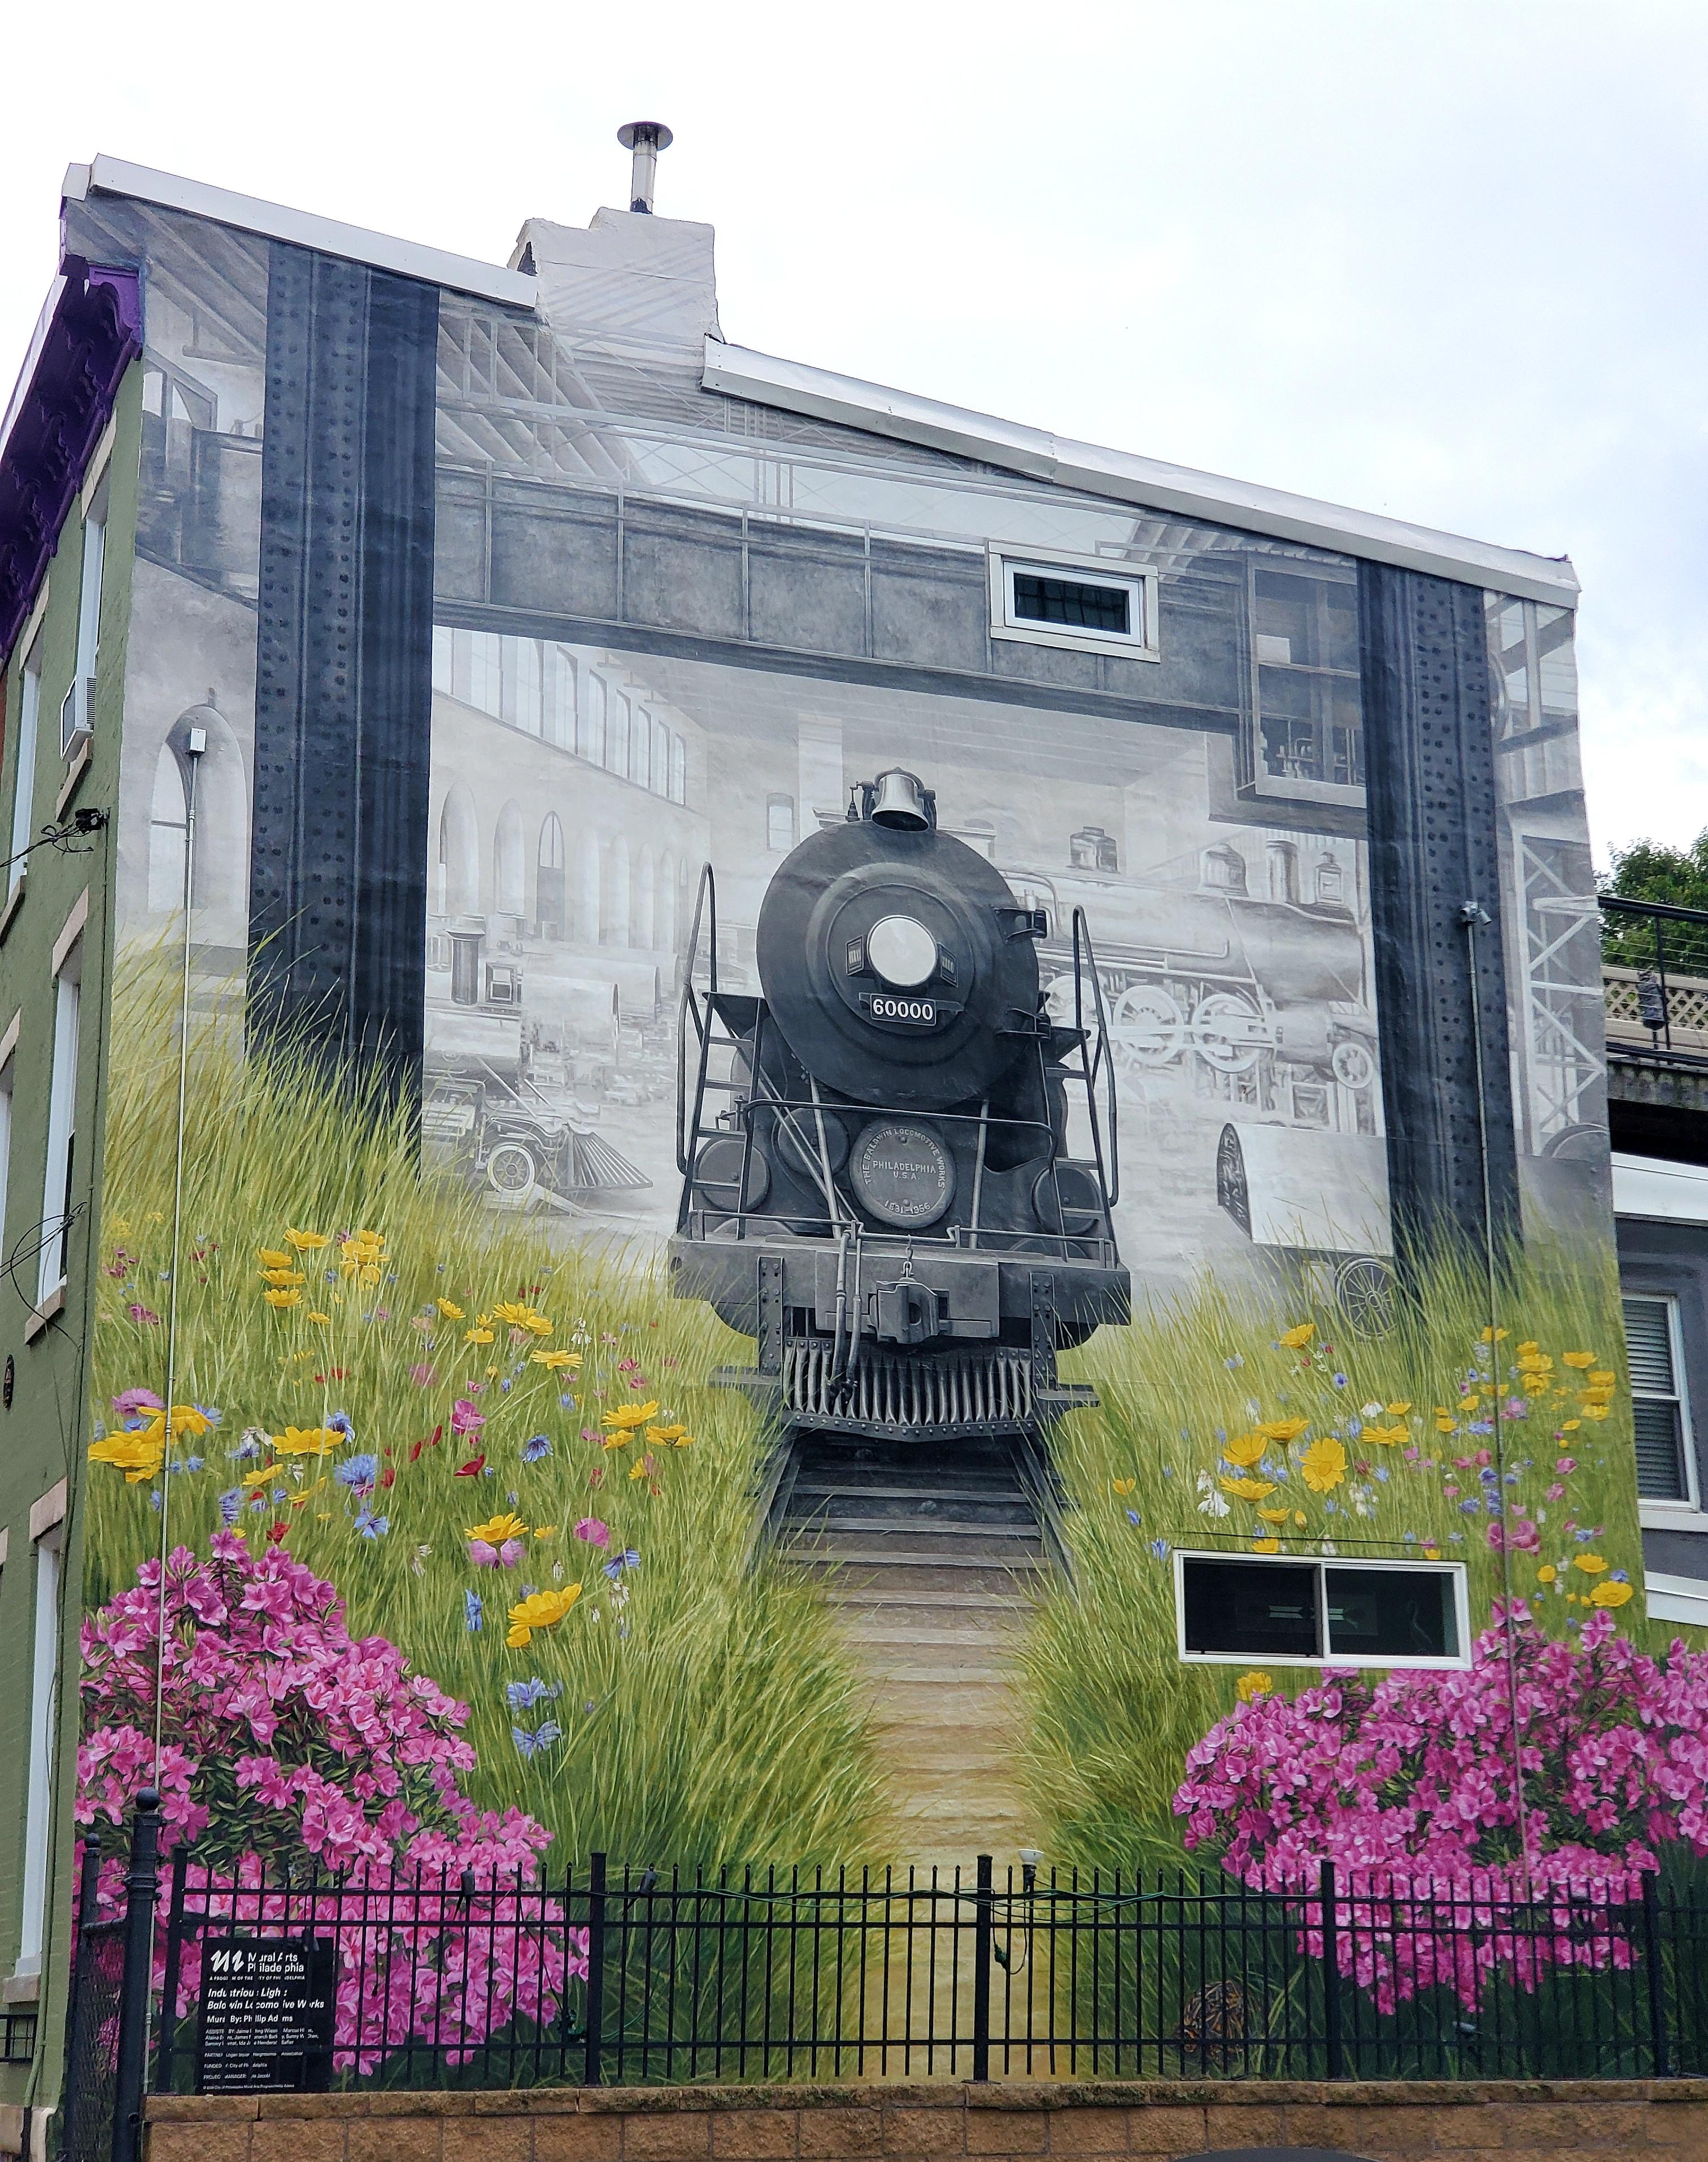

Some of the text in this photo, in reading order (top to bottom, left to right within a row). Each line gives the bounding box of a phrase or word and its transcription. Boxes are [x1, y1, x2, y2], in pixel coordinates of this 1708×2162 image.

[873, 999, 933, 1020] 60000
[862, 1128, 945, 1188] THE BALDWIN LOCOMOTIVE WORKS
[873, 1160, 936, 1174] PHILADELPHIA
[247, 1962, 304, 1974] Piladephia
[261, 1986, 287, 1999] Ligh:
[245, 1999, 295, 2010] Locomoive
[230, 2015, 242, 2024] By:
[243, 2014, 266, 2024] Phllip
